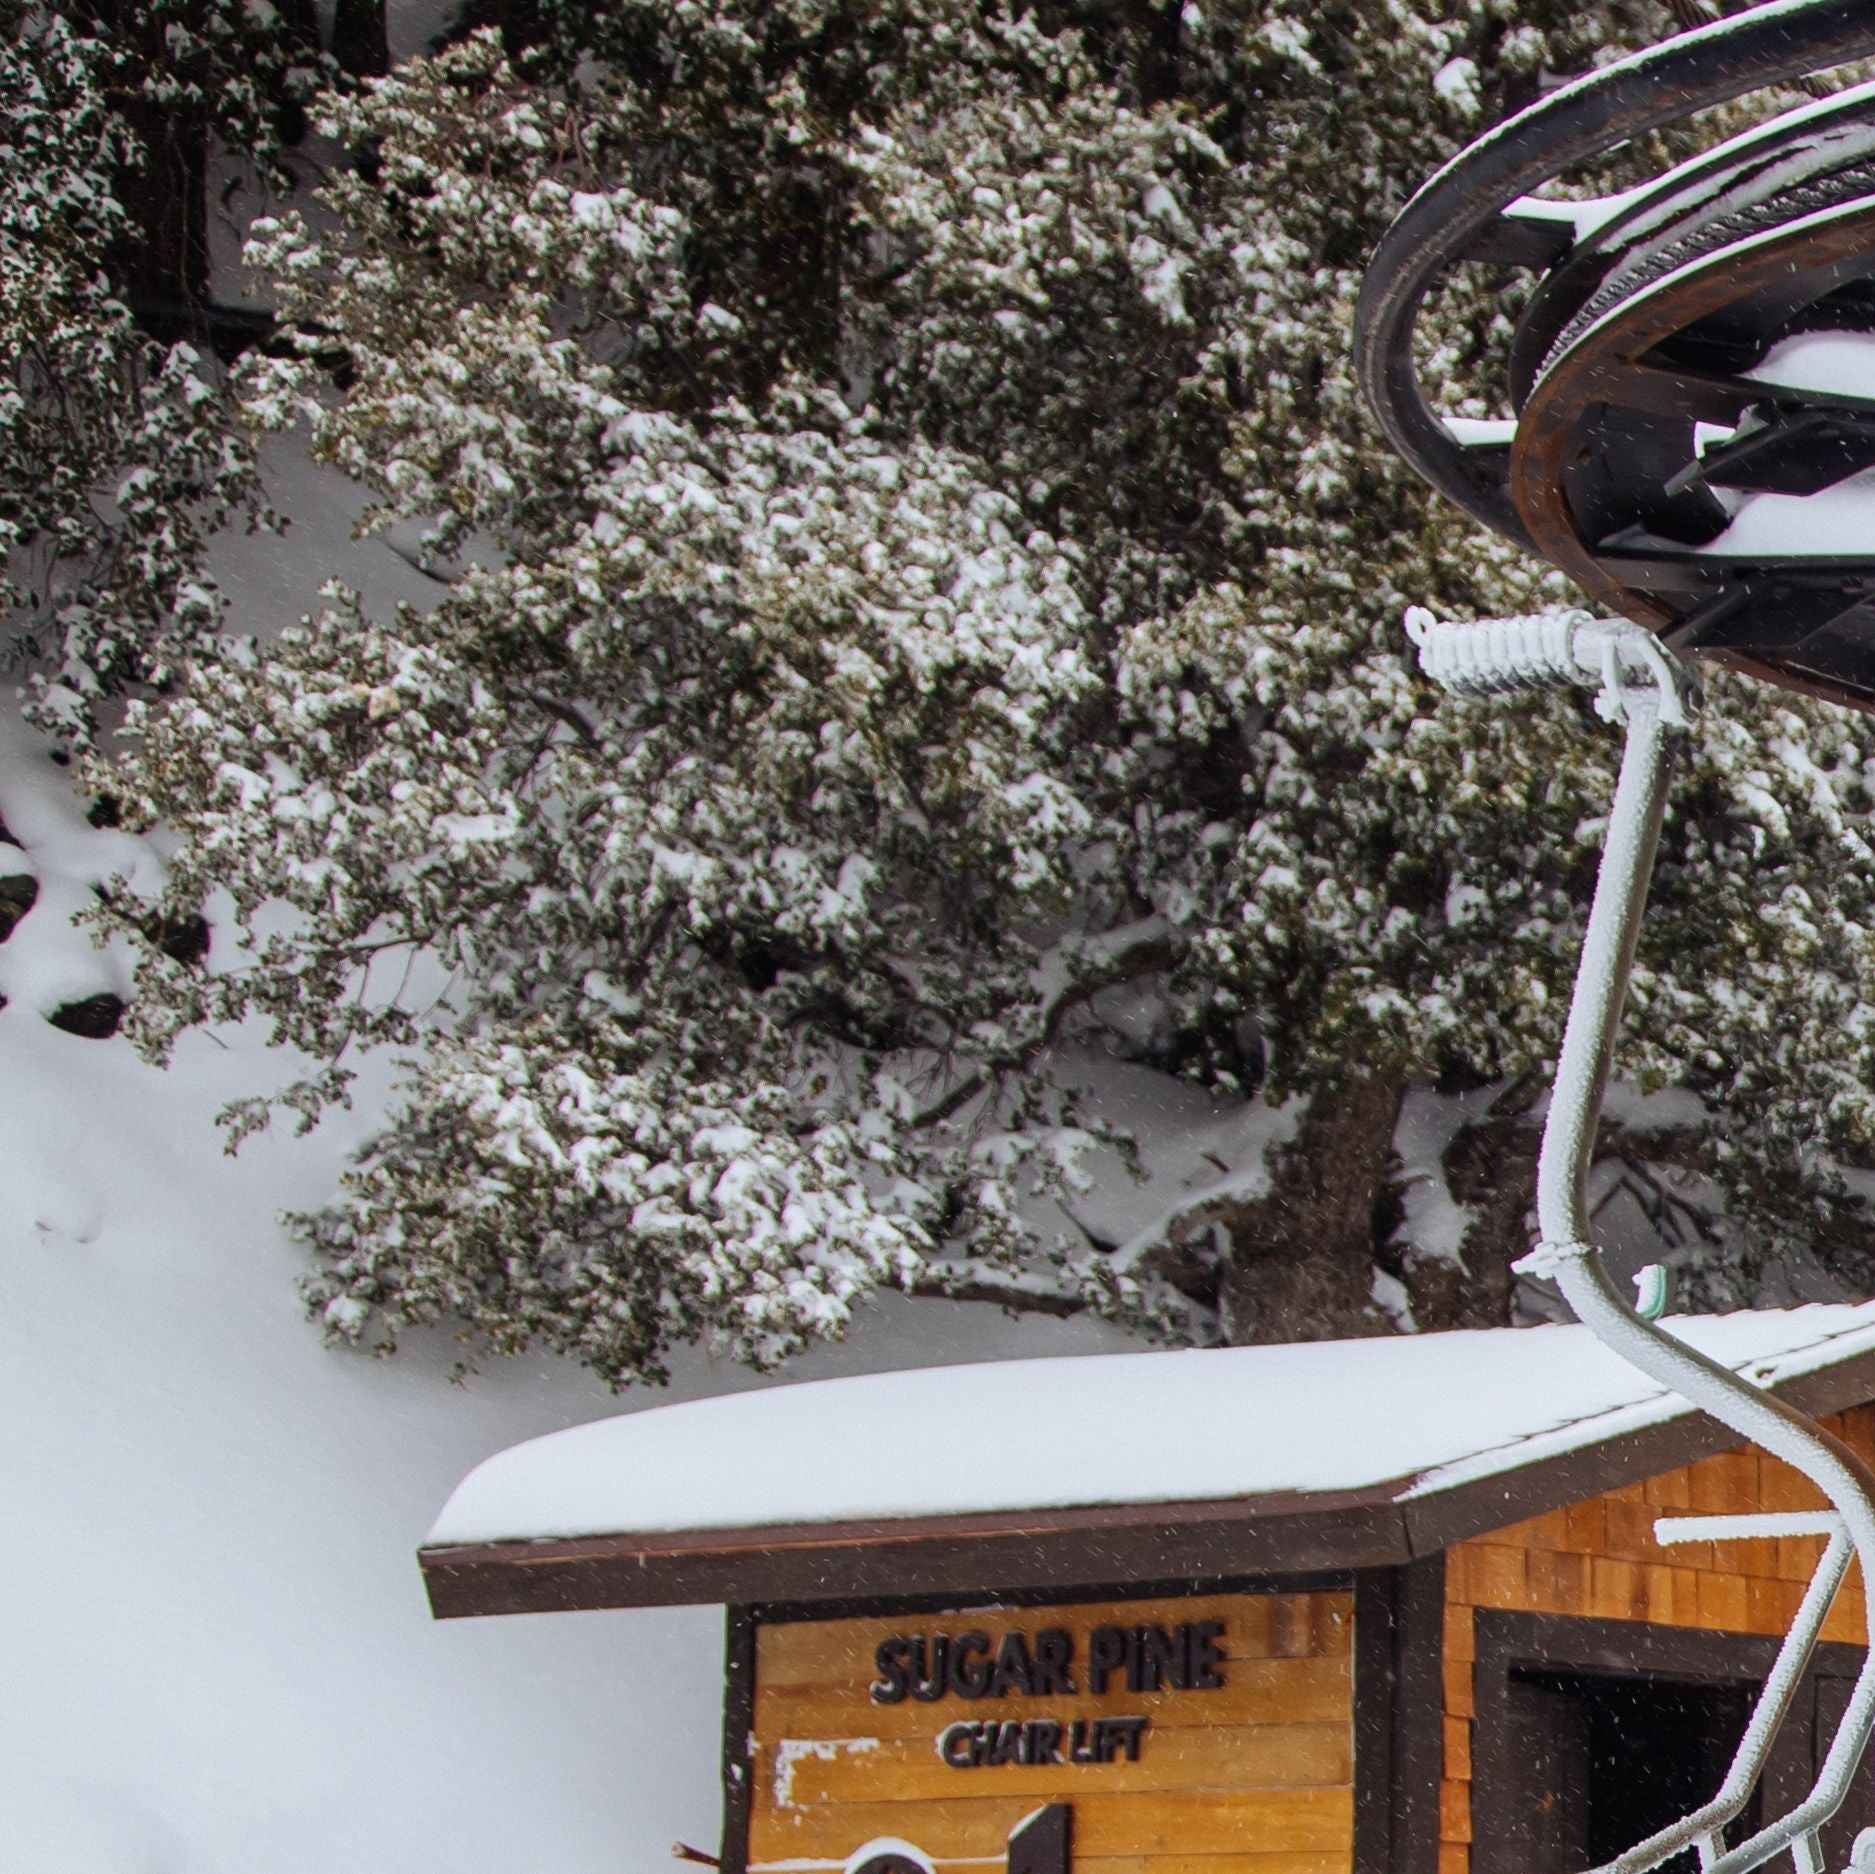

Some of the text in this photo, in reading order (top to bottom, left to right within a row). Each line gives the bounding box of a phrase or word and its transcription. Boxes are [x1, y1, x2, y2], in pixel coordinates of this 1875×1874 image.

[870, 1620, 1227, 1705] SUGAR PINE
[937, 1716, 1147, 1768] CHAIR LIFT
